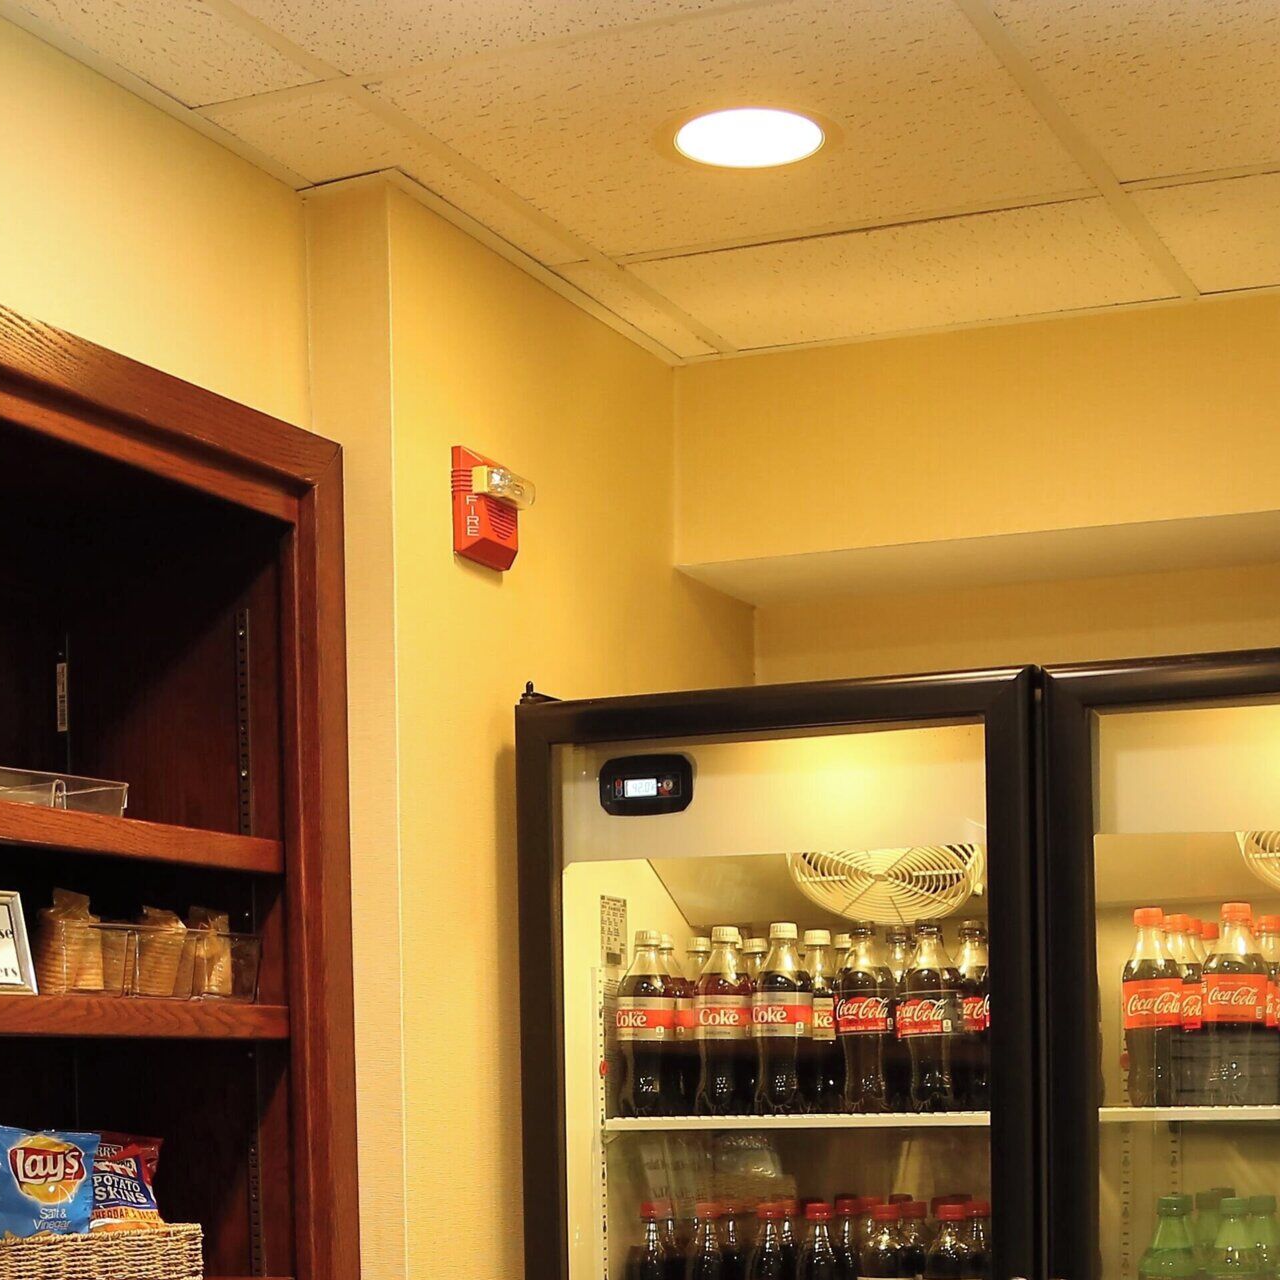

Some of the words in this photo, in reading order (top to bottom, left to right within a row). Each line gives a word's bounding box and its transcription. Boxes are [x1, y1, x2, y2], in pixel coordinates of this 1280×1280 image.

[465, 495, 480, 537] FIRE
[1127, 991, 1181, 1017] Coca-Cola
[1208, 986, 1258, 1006] Coca-Cola
[699, 1009, 739, 1026] Coke
[752, 1006, 787, 1023] Coke
[836, 997, 890, 1021] Coca-Cola
[616, 1010, 647, 1027] Coke
[814, 1012, 833, 1028] ke
[18, 1149, 80, 1184] Lay's
[93, 1176, 140, 1192] POTATO
[95, 1187, 147, 1203] SKINS
[39, 1207, 60, 1218] Salt
[33, 1218, 71, 1231] Vinegar
